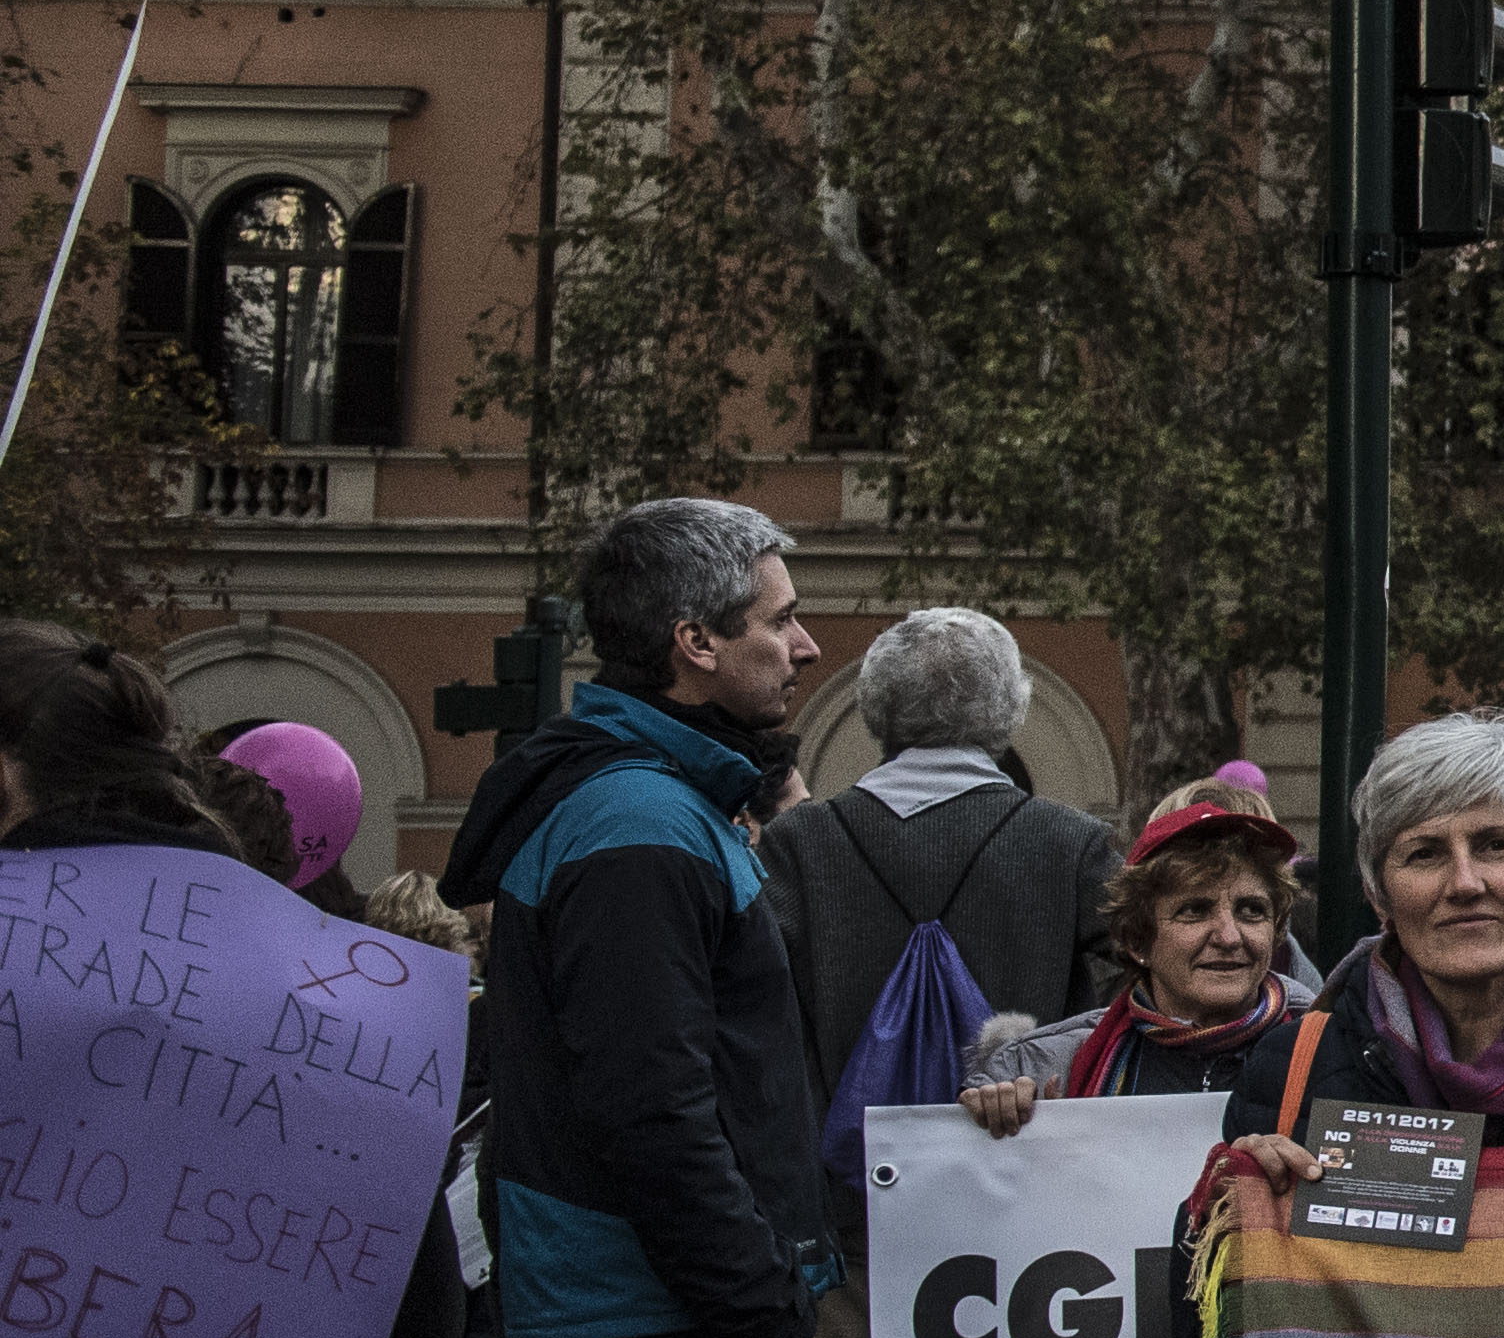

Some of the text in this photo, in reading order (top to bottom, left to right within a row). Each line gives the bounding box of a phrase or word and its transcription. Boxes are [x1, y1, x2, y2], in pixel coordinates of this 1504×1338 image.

[140, 877, 222, 948] LE
[264, 992, 443, 1108] DELLA
[1324, 1130, 1351, 1143] NO
[1342, 1109, 1455, 1131] 25112017
[1390, 1138, 1436, 1149] VIOLENZA
[163, 1166, 400, 1293] ESSERE
